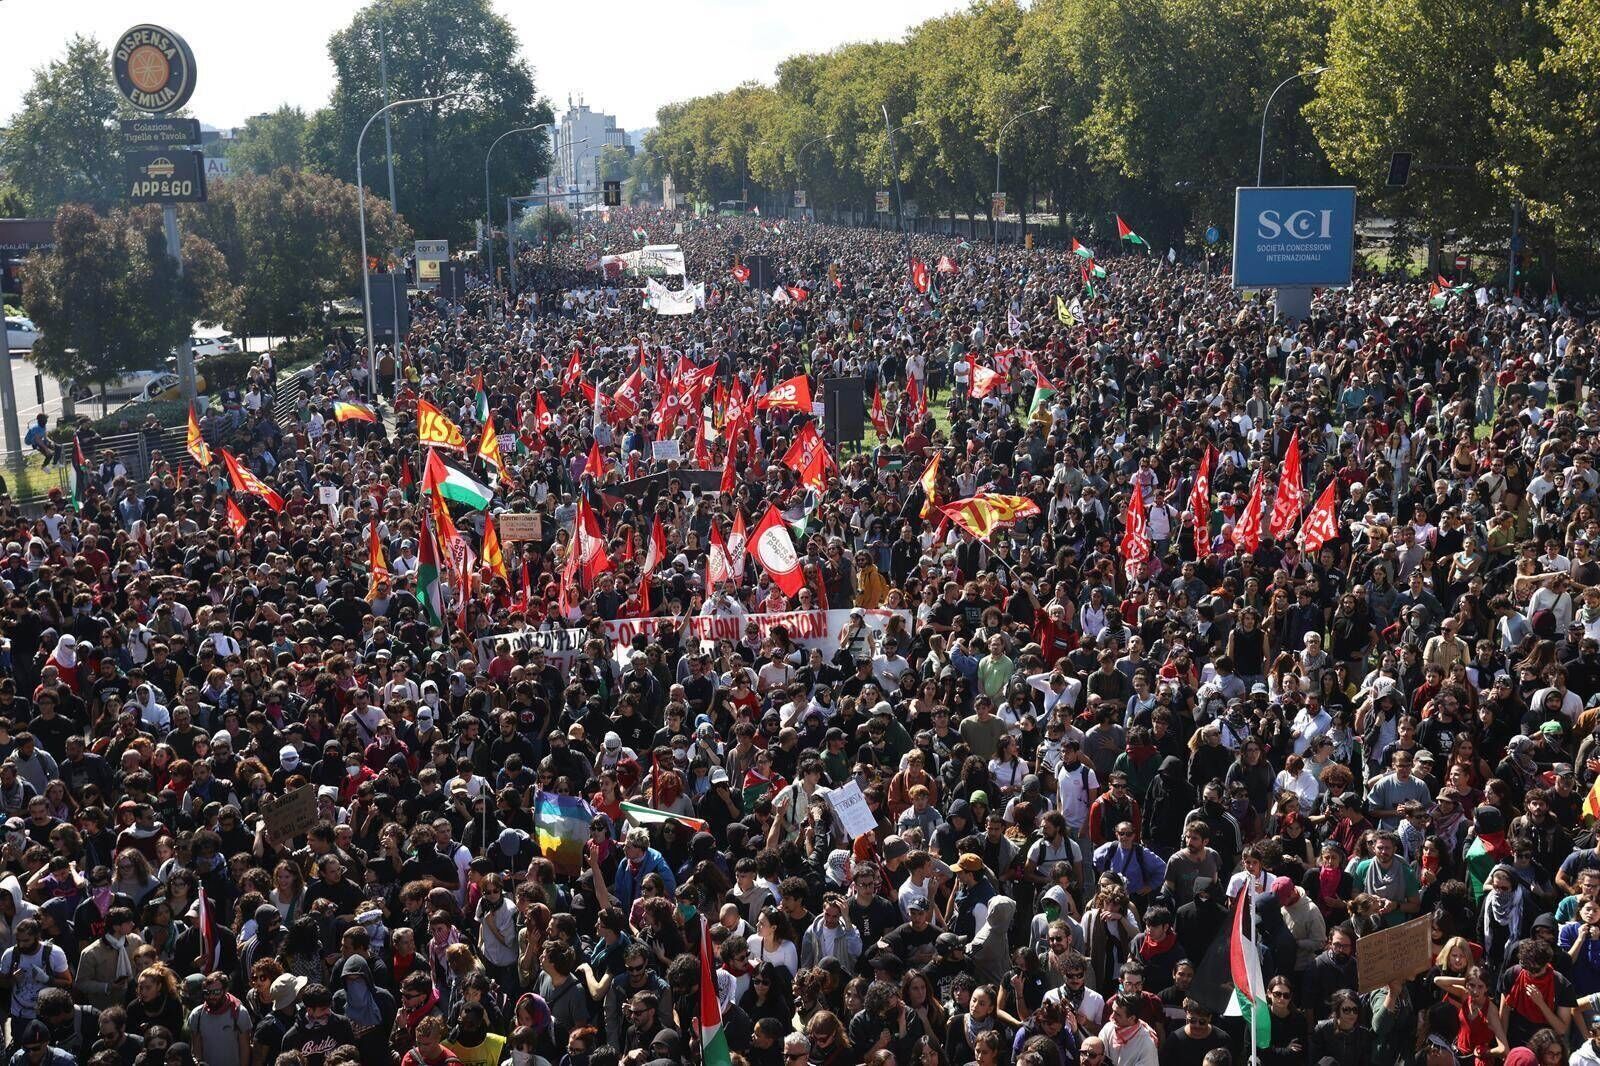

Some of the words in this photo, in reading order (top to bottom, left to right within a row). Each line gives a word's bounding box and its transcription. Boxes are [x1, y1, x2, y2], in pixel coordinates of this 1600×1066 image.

[116, 30, 176, 62] DISPENSA
[130, 87, 176, 108] EMILIA
[131, 181, 192, 197] APP&GO
[1258, 209, 1333, 239] SCI
[1256, 243, 1285, 252] SOCIETÀ
[1286, 243, 1331, 252] CONCESSIONI
[1266, 254, 1321, 262] INTERNAZIONALI
[766, 530, 789, 555] potere
[766, 540, 790, 565] popolo
[689, 615, 740, 641] MELONI
